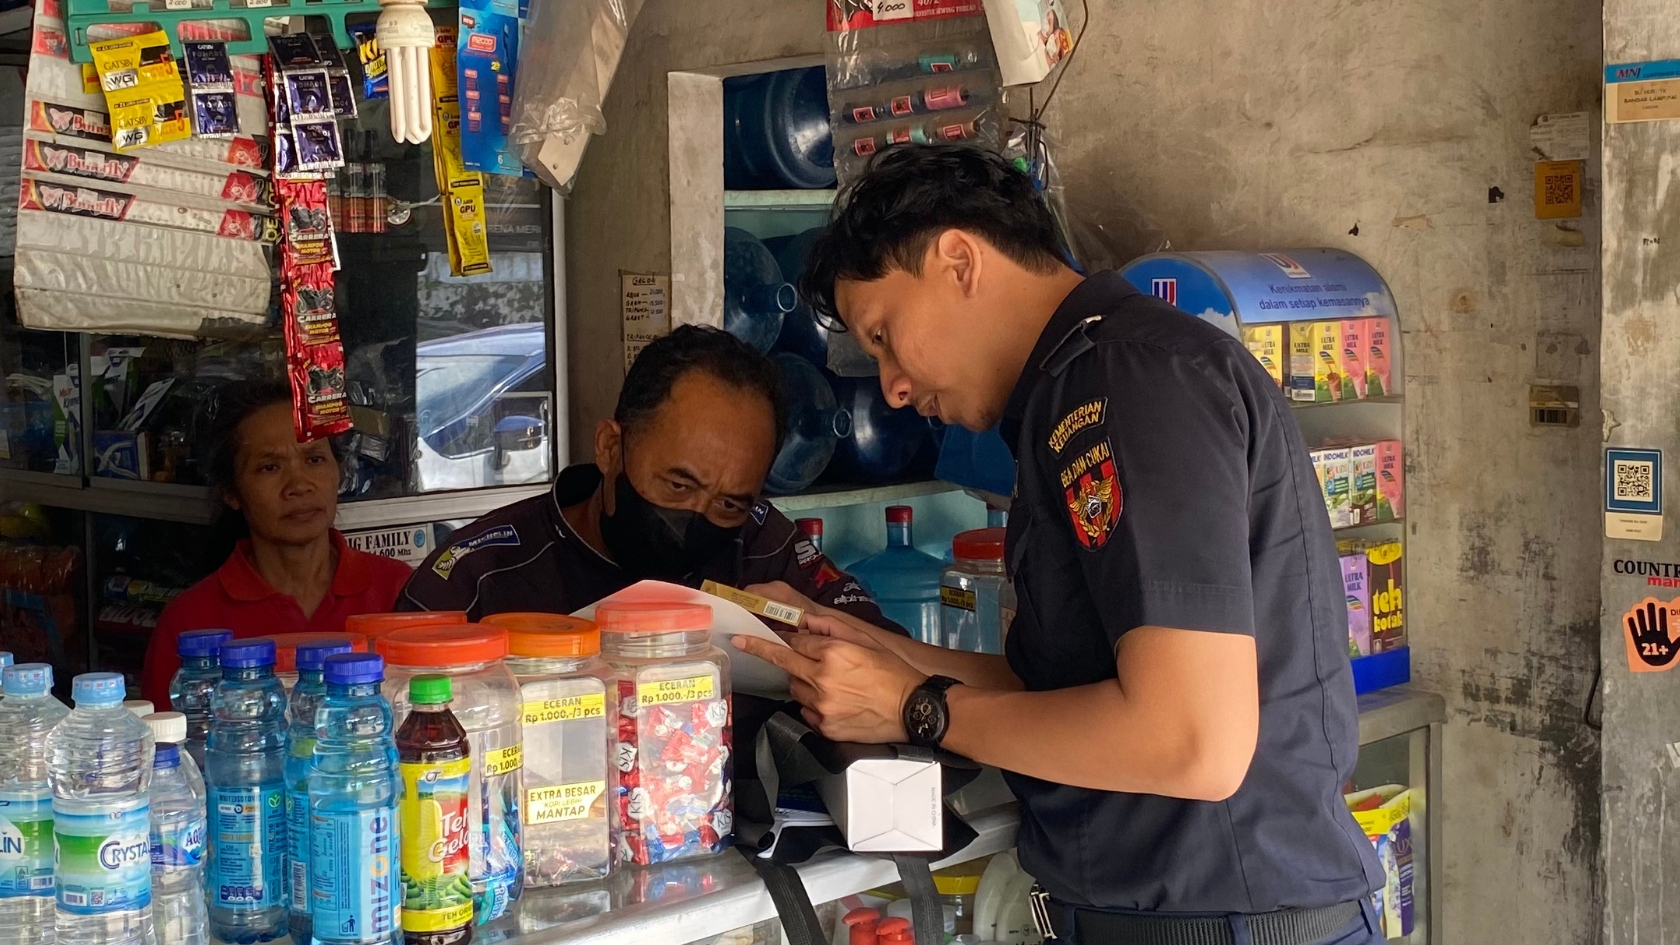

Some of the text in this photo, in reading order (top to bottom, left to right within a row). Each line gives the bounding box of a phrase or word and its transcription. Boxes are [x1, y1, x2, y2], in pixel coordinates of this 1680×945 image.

[437, 35, 457, 44] GPU
[103, 58, 135, 70] GATSBY
[1617, 68, 1642, 78] MNJ
[110, 74, 133, 85] WG
[448, 121, 460, 130] GP
[123, 132, 144, 142] WG
[460, 205, 476, 215] GPU
[288, 233, 329, 242] CARRERA
[295, 242, 325, 250] SHAMPOO
[1267, 283, 1347, 294] Kenikmatan alami
[1259, 296, 1370, 310] dalam setiap kemasannya
[297, 313, 337, 323] CARRERA
[305, 322, 333, 330] SHAMPOO
[309, 327, 331, 335] MOTOR
[1321, 336, 1335, 344] ULTRA
[1372, 331, 1385, 339] ULTRA
[1373, 338, 1384, 346] MILK
[307, 392, 347, 403] CARRERA
[315, 402, 343, 411] SHAMPOO
[1048, 401, 1102, 448] KEMENTERIAN
[1054, 412, 1099, 453] KEUANGAN
[1324, 452, 1349, 460] INDOMILK
[1353, 448, 1375, 457] INDOMILK
[348, 531, 411, 551] IG FAMILY
[468, 530, 514, 546] MICHELIN
[1345, 572, 1363, 583] ULTRA
[1347, 582, 1362, 592] MILK
[1372, 579, 1402, 615] teh
[1374, 612, 1403, 633] kotak
[1641, 643, 1669, 656] 21+
[659, 679, 696, 692] ECERAN
[641, 688, 713, 704] Rp 1.000,-/3 pcs
[543, 697, 582, 710] ECERAN
[525, 706, 601, 724] Rp 1.000,-/3 pcs
[487, 763, 498, 774] Rp
[530, 785, 596, 802] EXTRA BESAR
[536, 806, 586, 821] MANTAP
[0, 831, 21, 854] IN
[369, 817, 389, 934] mizone
[442, 911, 457, 921] TEH
